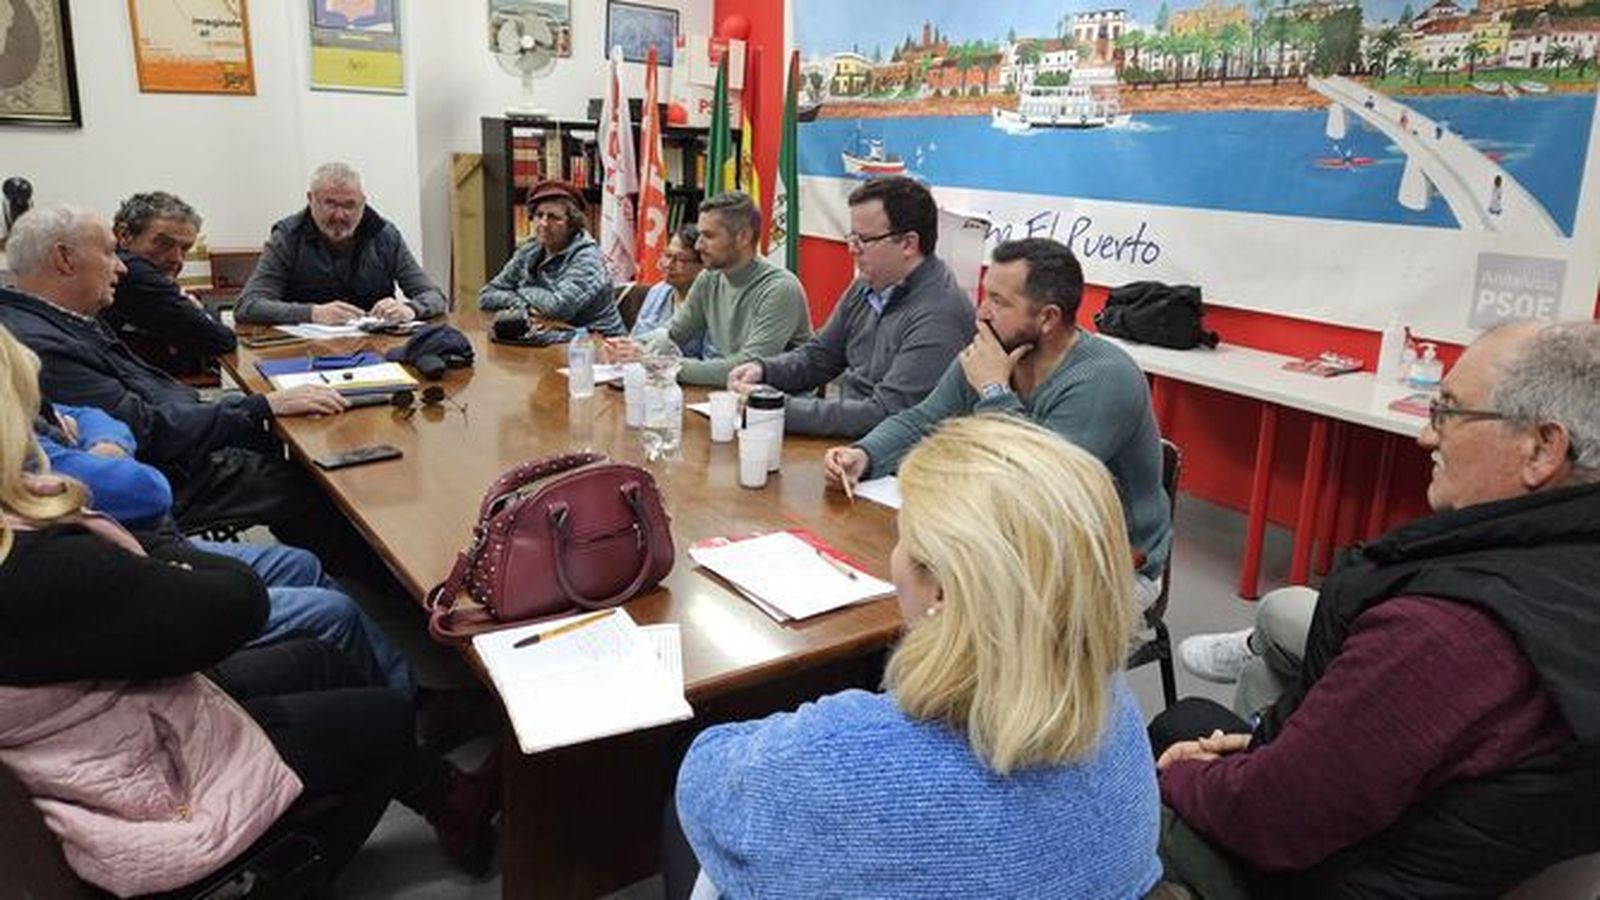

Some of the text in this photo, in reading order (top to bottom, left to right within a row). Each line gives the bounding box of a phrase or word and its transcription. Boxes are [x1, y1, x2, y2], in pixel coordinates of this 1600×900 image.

[1026, 210, 1061, 240] El
[1067, 216, 1160, 265] Puerto
[1476, 289, 1555, 319] PSOE
